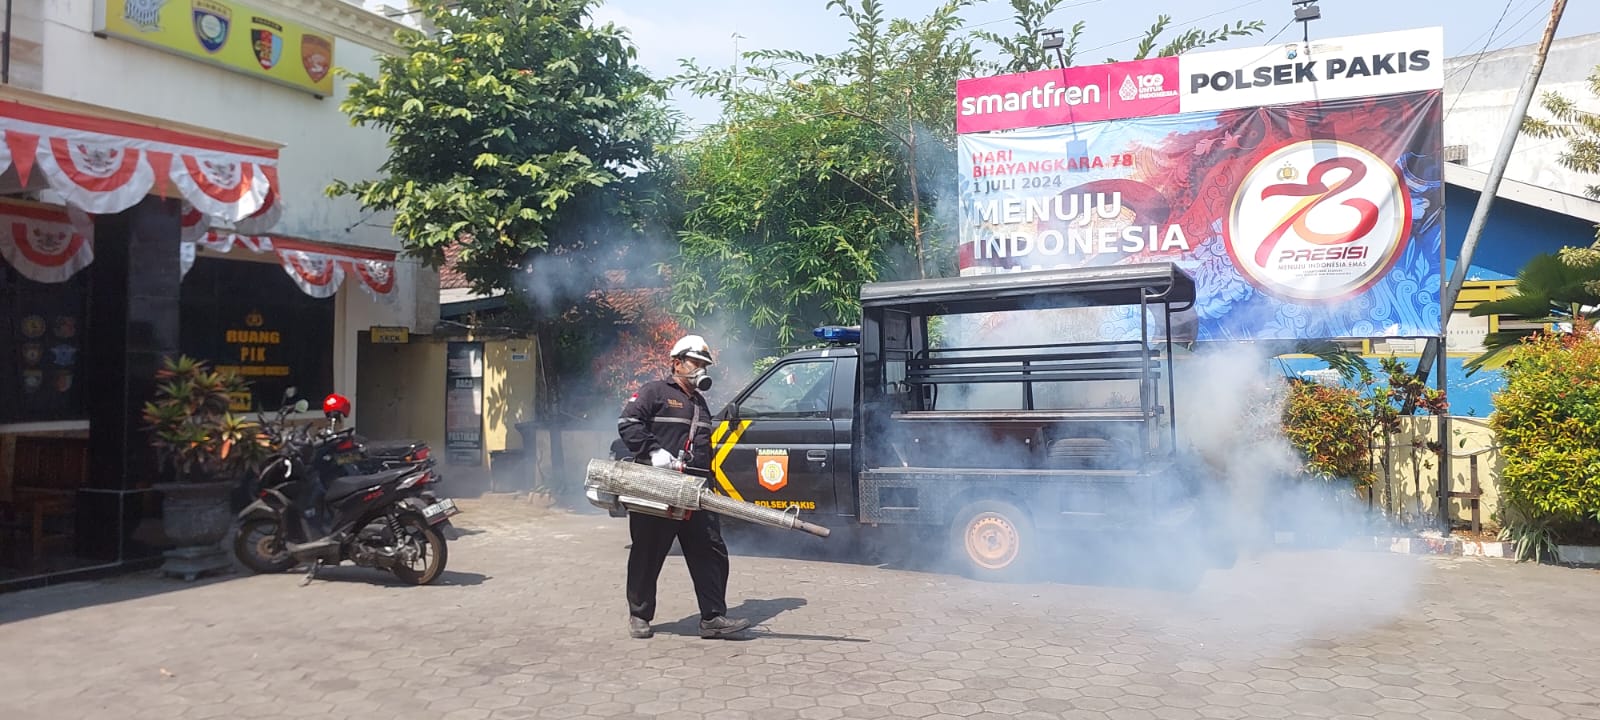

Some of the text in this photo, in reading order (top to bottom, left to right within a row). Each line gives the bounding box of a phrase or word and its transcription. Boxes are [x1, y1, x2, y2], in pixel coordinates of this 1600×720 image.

[1190, 49, 1431, 94] POLSEK PAKIS
[1136, 73, 1164, 88] 100
[961, 82, 1100, 116] smartfren
[1139, 90, 1178, 99] INDONESIA
[972, 149, 1013, 164] HARI
[972, 153, 1133, 178] BHAYANGKARA 78
[973, 175, 1062, 194] 1 JULI 2024
[973, 191, 1122, 227] MENUJU
[973, 224, 1190, 260] INDONESIA
[1279, 246, 1369, 262] PRESISI
[226, 330, 280, 343] RUANG
[241, 347, 265, 361] PIK
[755, 500, 816, 510] POLSEK PAKIS
